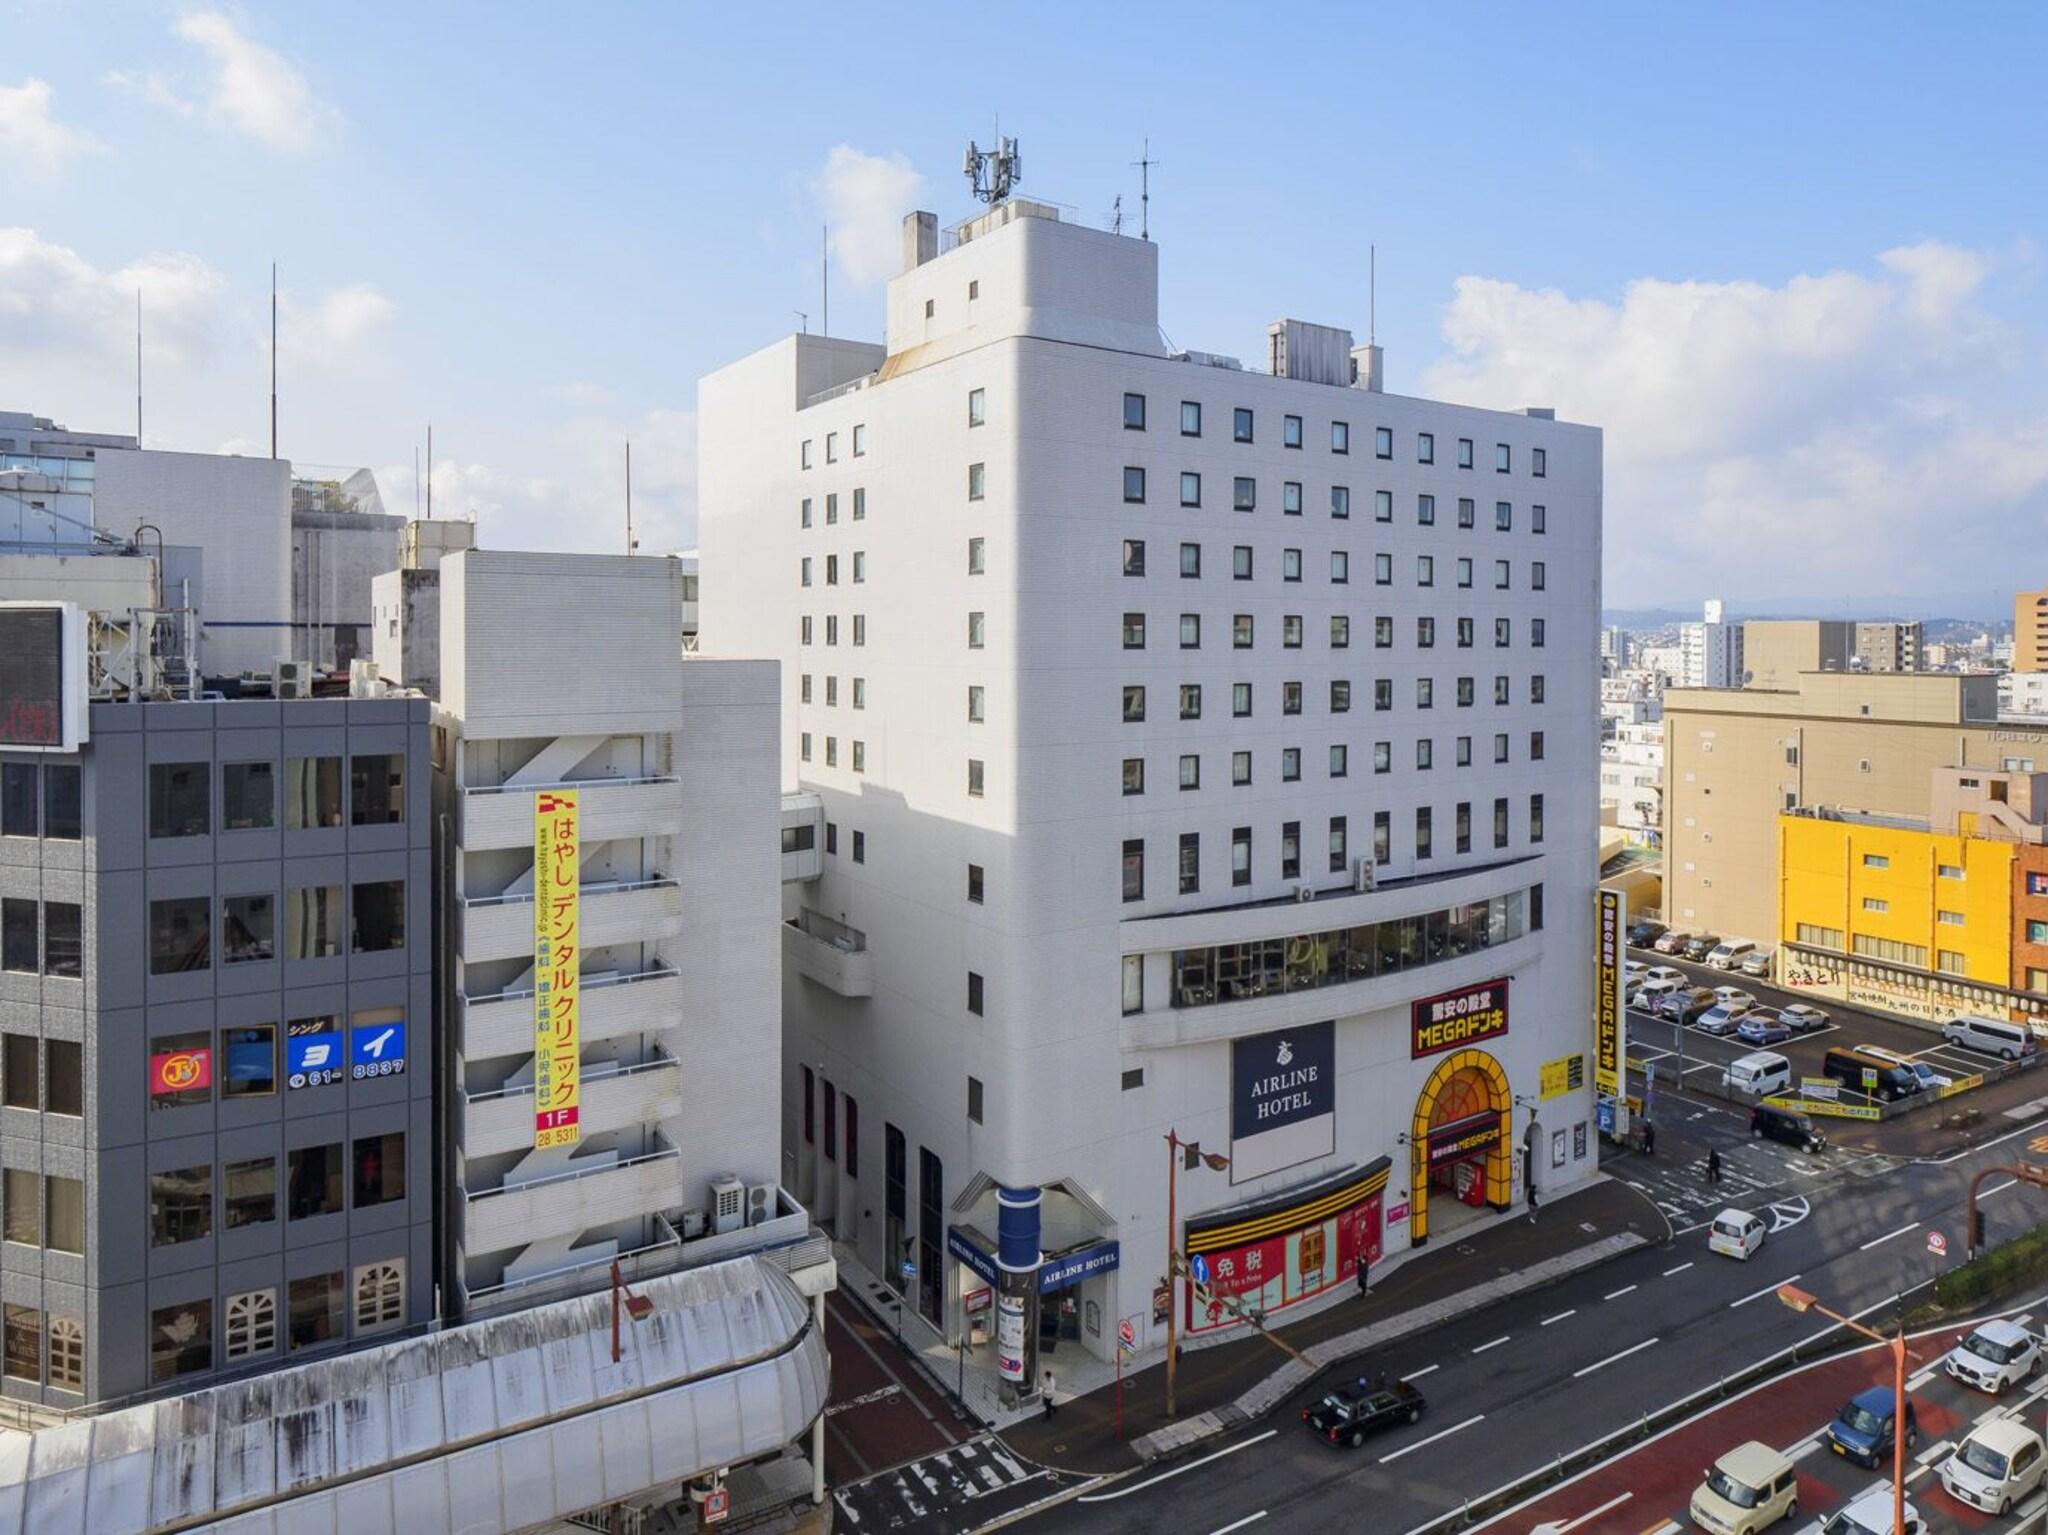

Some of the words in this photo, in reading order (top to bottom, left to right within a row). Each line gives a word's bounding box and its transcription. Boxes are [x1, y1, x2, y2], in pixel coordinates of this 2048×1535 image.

[289, 1021, 324, 1036] シング
[1418, 1008, 1503, 1050] MEGAドンキ
[352, 1059, 404, 1079] 8837
[1251, 1066, 1318, 1097] AIRLINE
[546, 1109, 569, 1127] 1F
[1258, 1091, 1312, 1119] HOTEL
[538, 1132, 551, 1147] 28
[556, 1127, 577, 1143] 5311
[1044, 1261, 1083, 1284] AIRLINE
[1085, 1252, 1117, 1269] HOTEL
[1217, 1249, 1263, 1279] 免税
